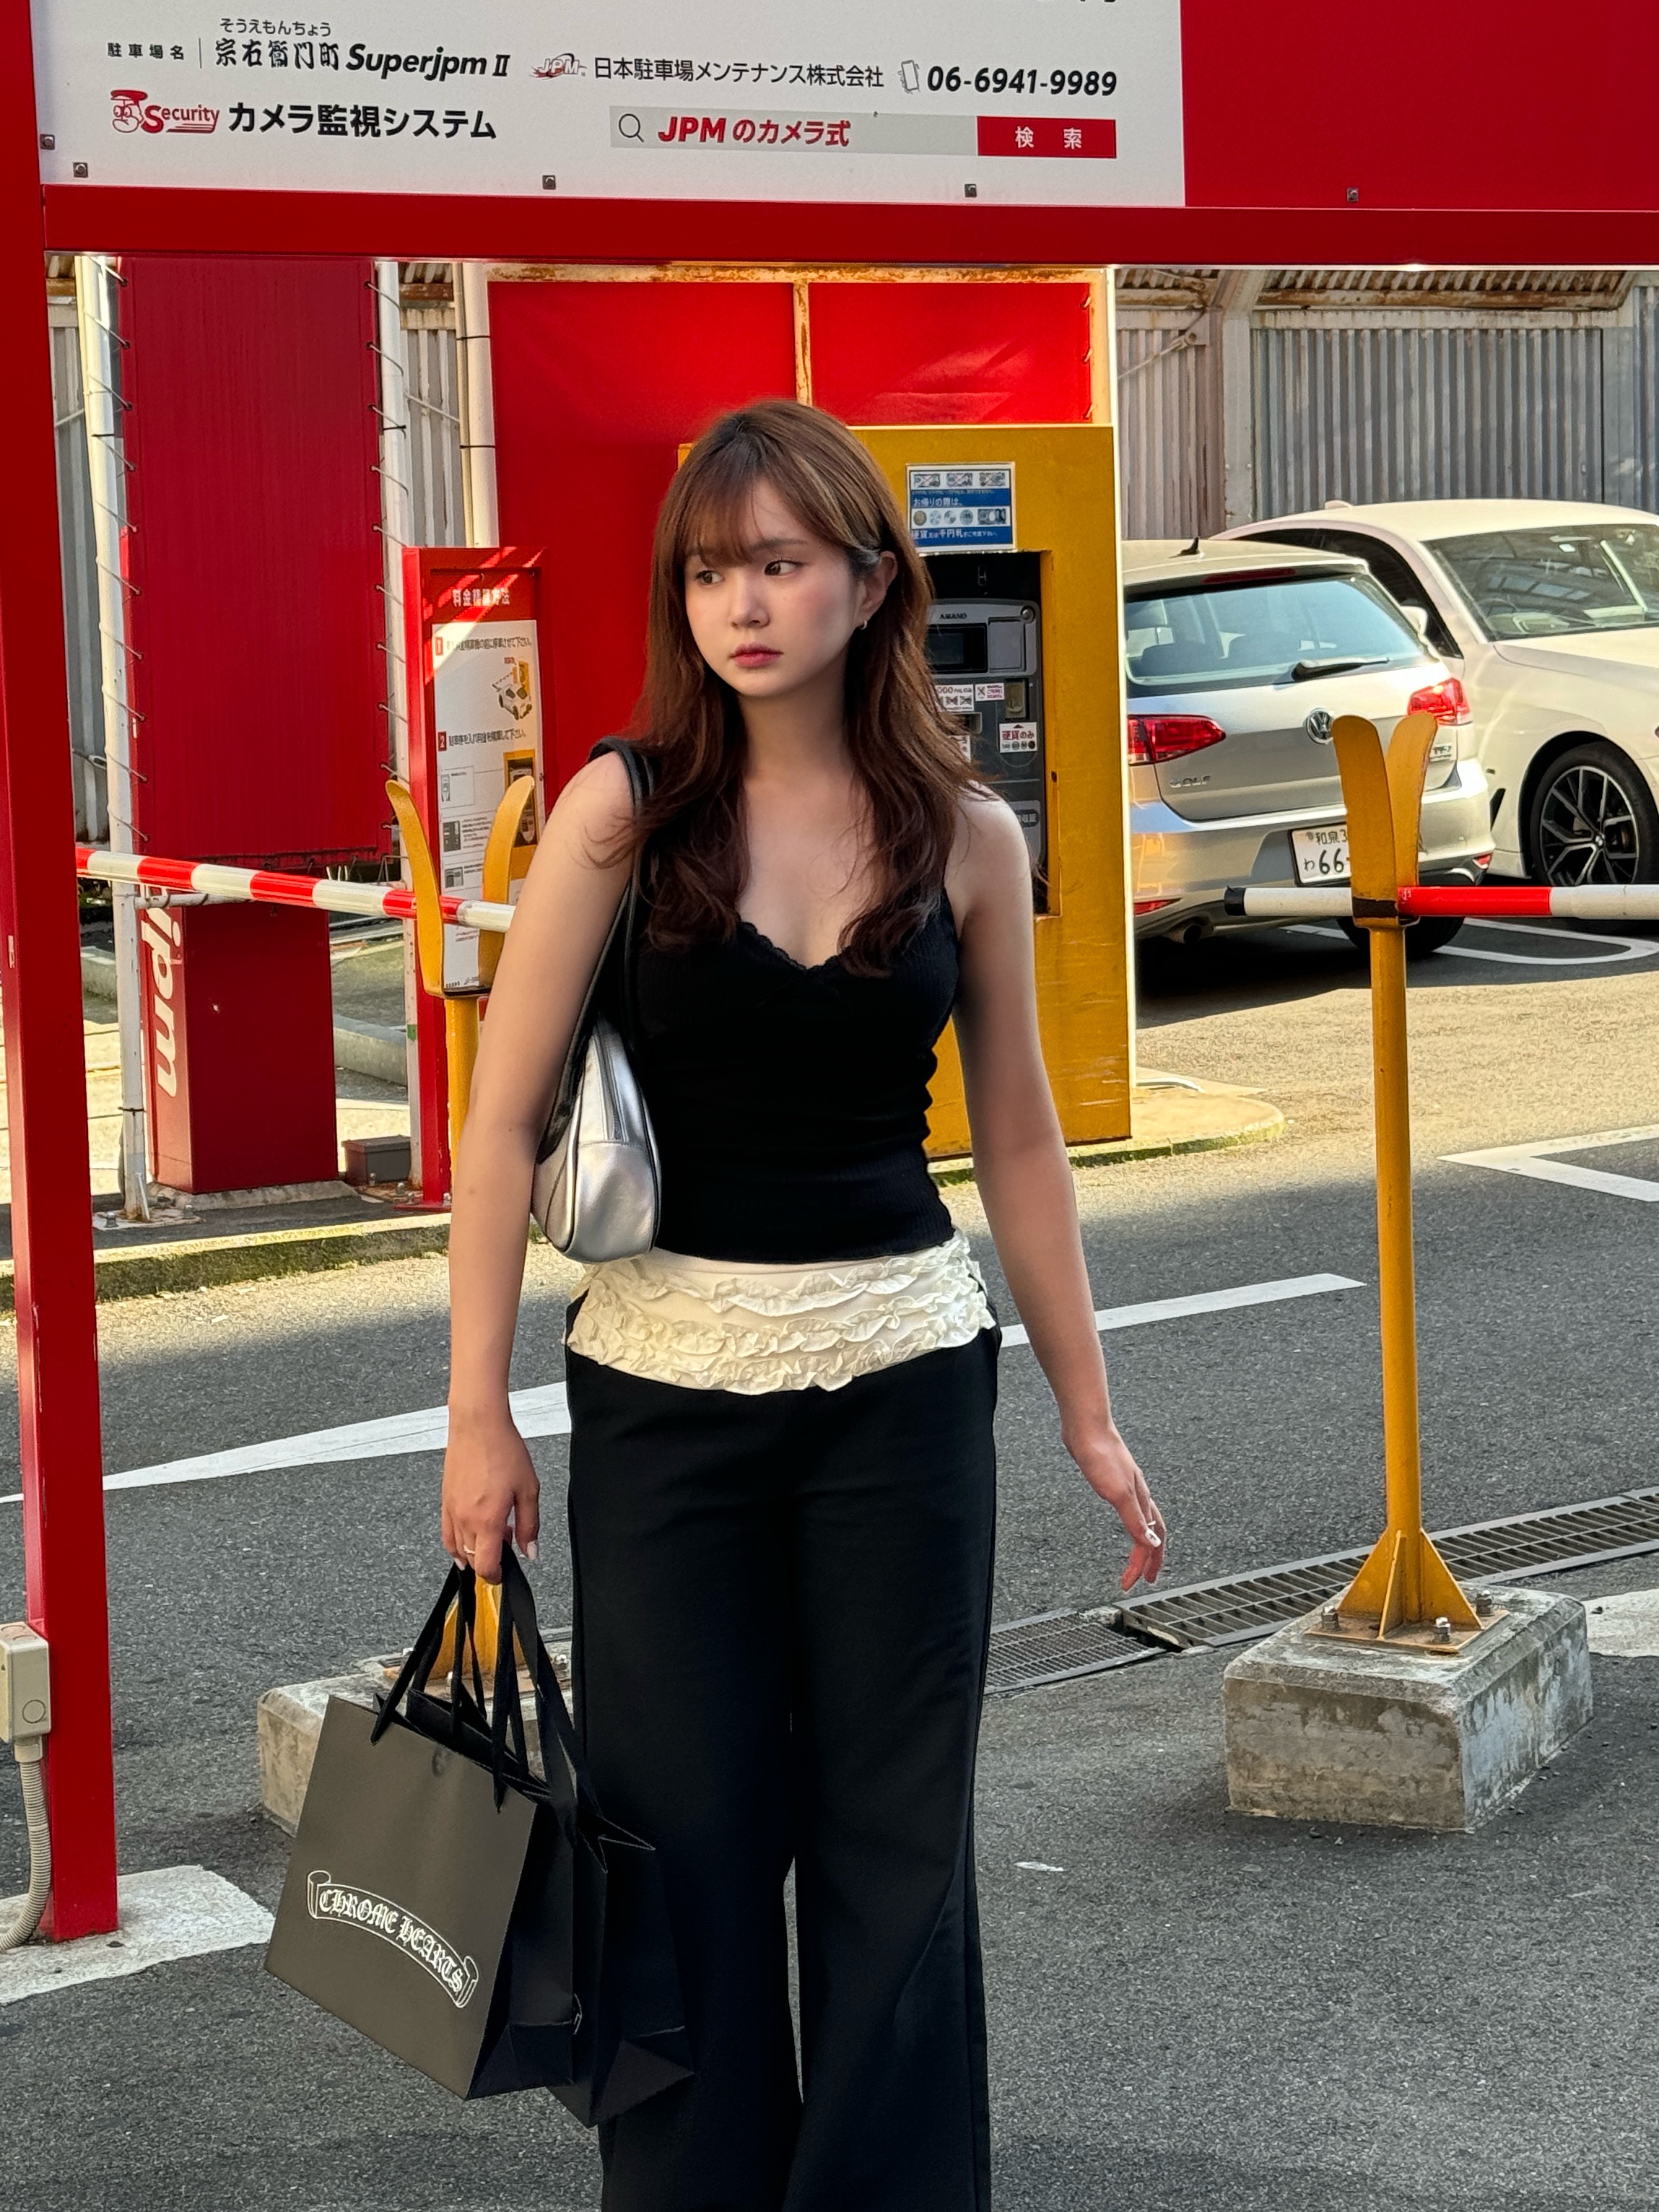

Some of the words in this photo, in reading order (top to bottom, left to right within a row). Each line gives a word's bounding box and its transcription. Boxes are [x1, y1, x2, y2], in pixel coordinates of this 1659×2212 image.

[220, 18, 331, 37] そうえもんちょう
[108, 42, 185, 60] 駐車場名
[345, 43, 487, 82] Superjpm
[594, 57, 883, 89] 日本駐車場メンテナンス株式会社
[927, 66, 1117, 97] 06-6941-9989
[142, 104, 219, 134] Security
[228, 102, 497, 141] カメラ監視システム
[658, 117, 726, 143] JPM
[732, 120, 852, 147] のカメラ式
[319, 1889, 399, 1934] CHROME
[396, 1915, 464, 1996] HEARTS
